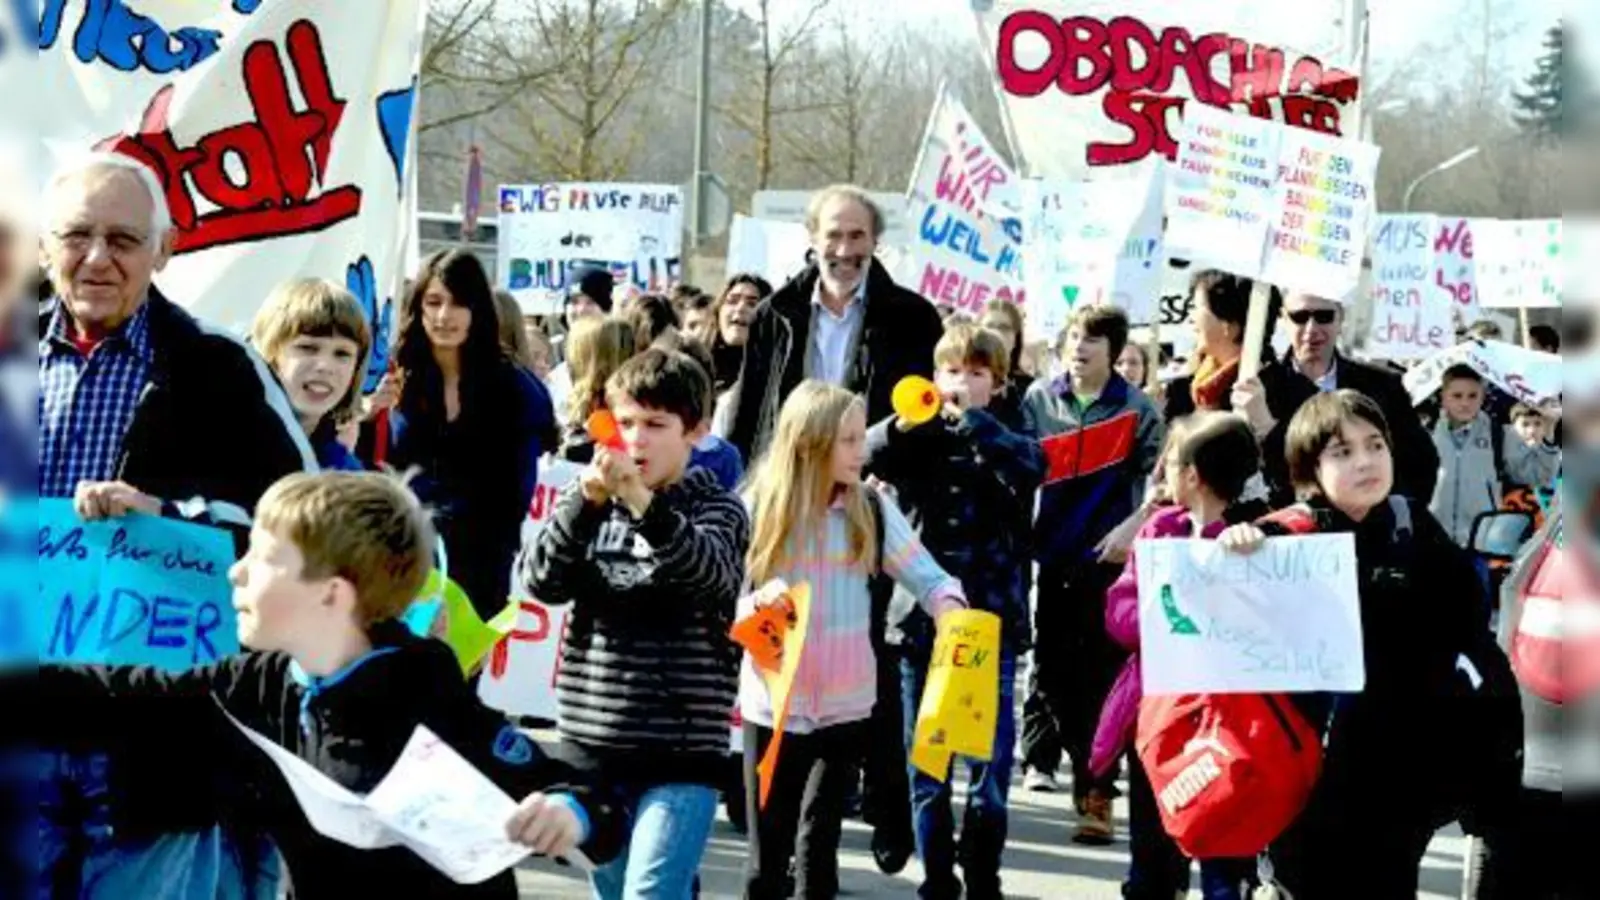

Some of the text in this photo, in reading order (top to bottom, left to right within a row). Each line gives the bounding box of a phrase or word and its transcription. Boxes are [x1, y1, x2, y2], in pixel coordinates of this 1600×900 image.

[500, 185, 560, 214] EWIG
[920, 202, 991, 265] WEIL
[919, 261, 993, 314] NEUE
